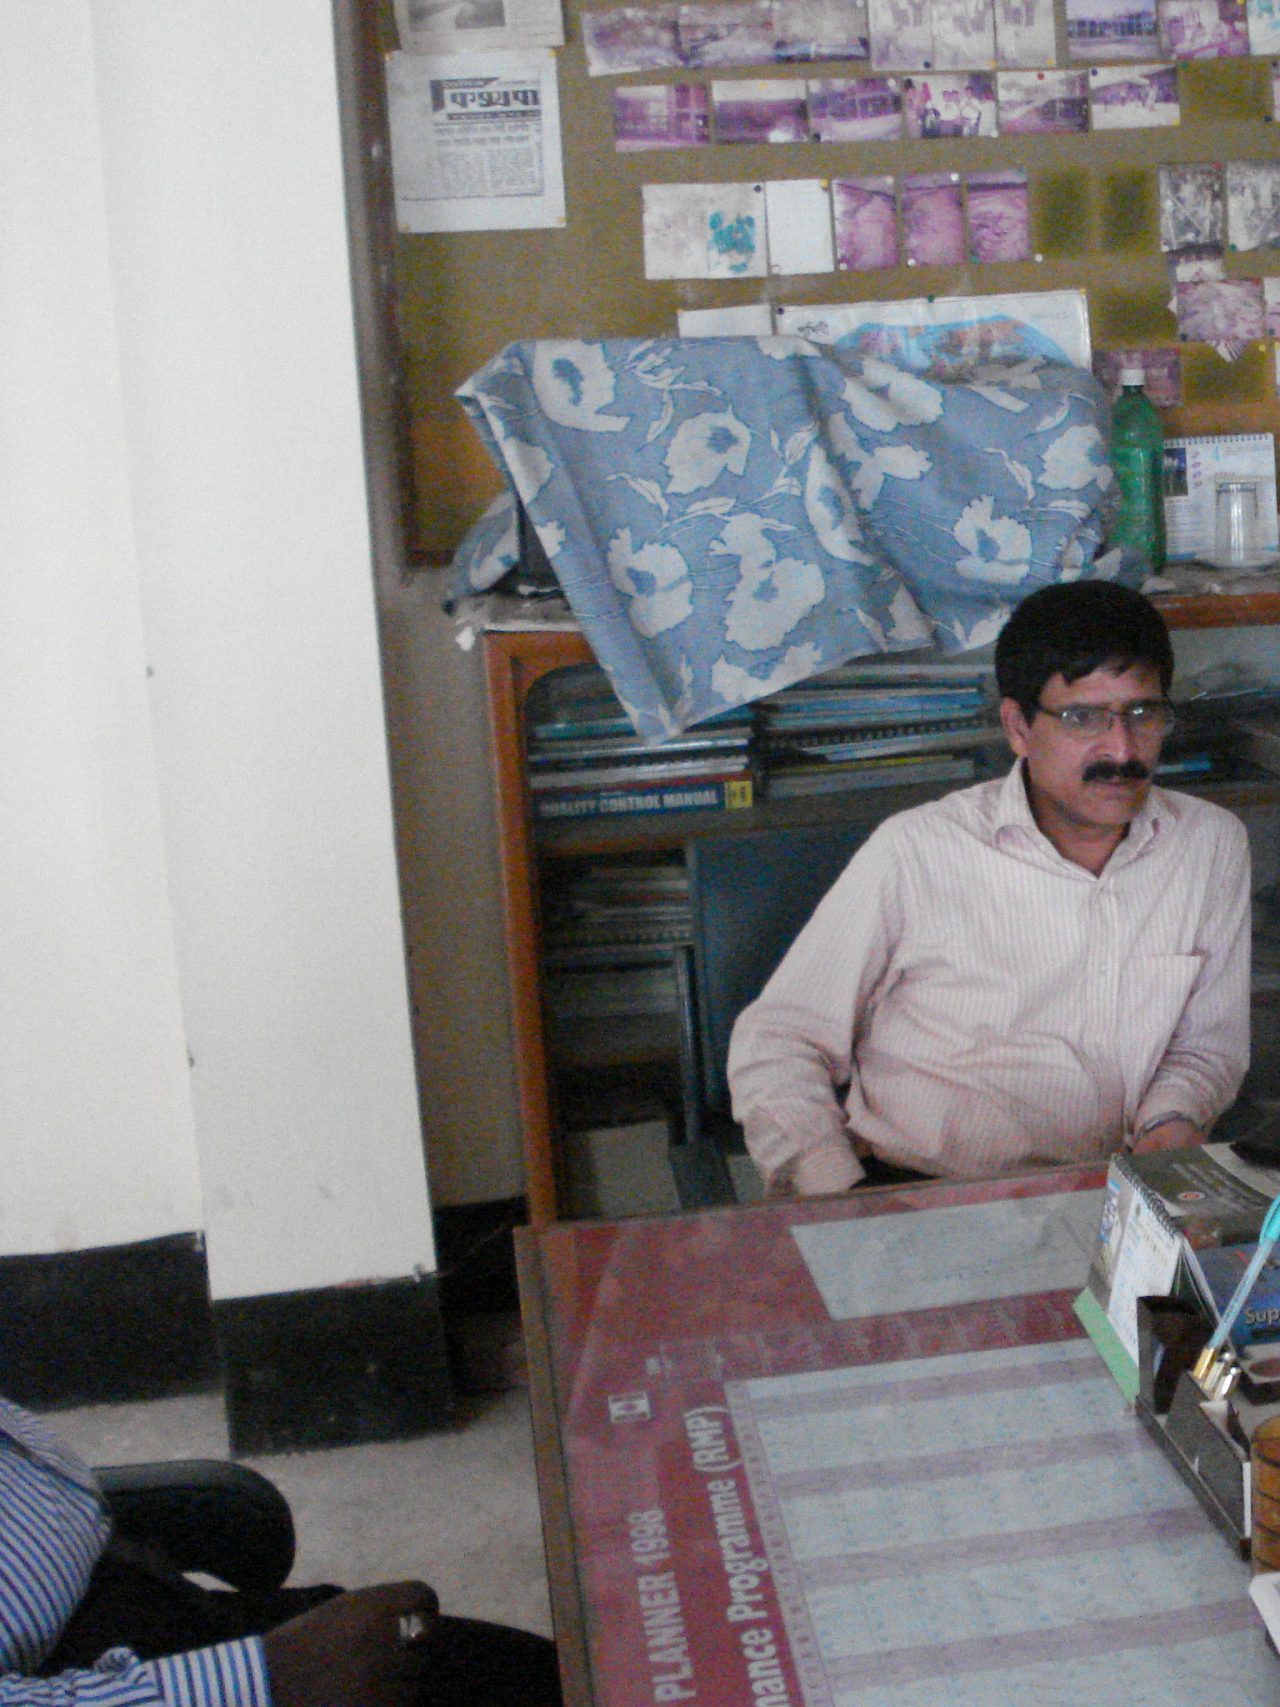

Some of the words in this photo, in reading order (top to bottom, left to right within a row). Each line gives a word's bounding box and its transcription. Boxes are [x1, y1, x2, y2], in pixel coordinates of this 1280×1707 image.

[599, 795, 661, 812] CONTROL
[664, 789, 718, 806] MANUAL
[684, 1406, 743, 1472] (RMP)
[628, 1509, 671, 1566] 1998
[706, 1477, 770, 1623] Programme
[637, 1571, 697, 1702] PLANNER
